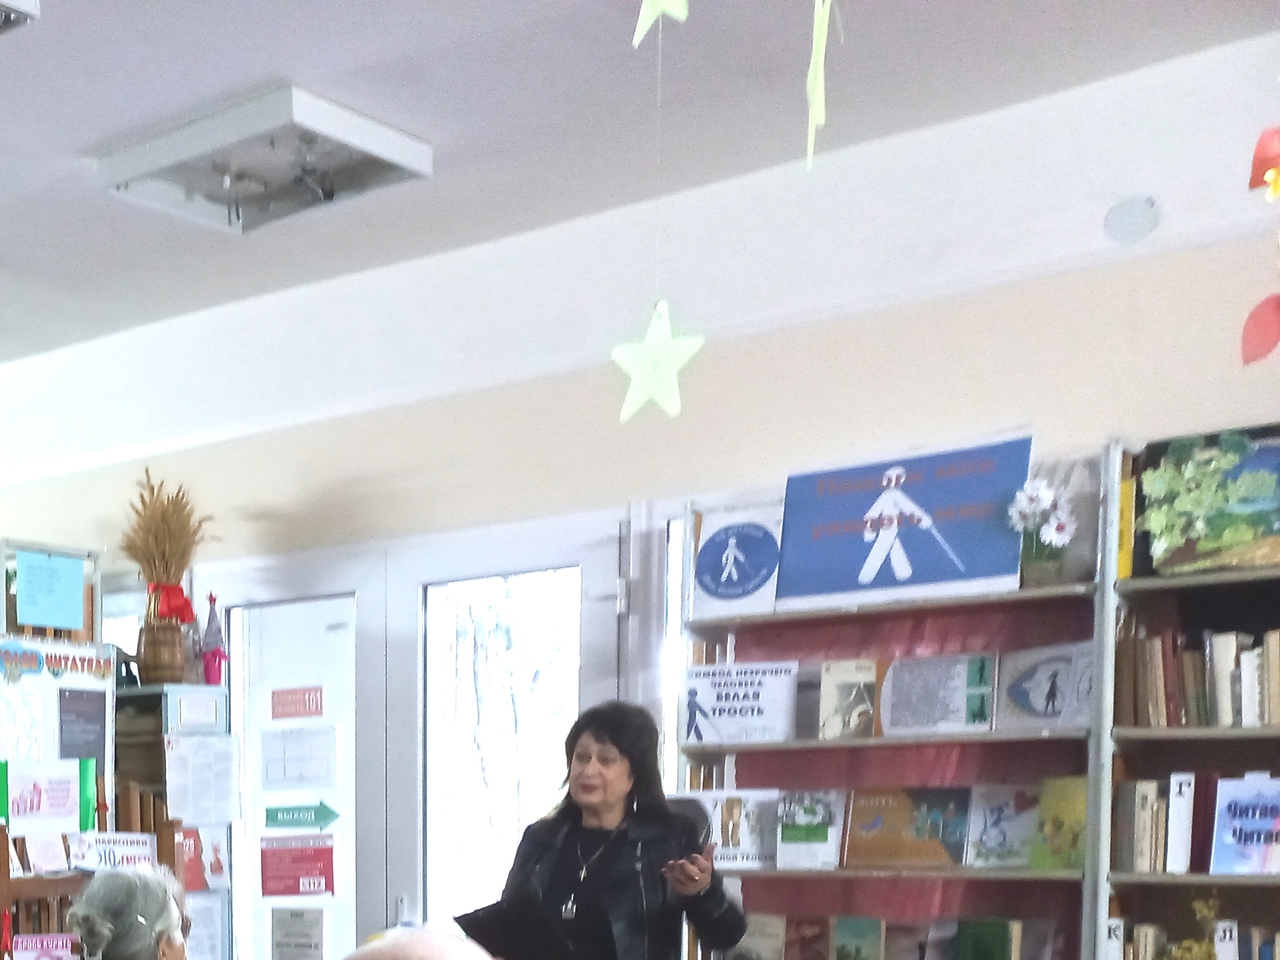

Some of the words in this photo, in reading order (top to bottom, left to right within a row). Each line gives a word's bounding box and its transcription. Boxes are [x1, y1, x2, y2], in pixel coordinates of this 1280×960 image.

[304, 690, 322, 711] 101
[716, 690, 760, 702] БЕЛАЯ
[711, 705, 764, 717] ТРОСТЬ
[277, 810, 315, 822] ВЫХОД
